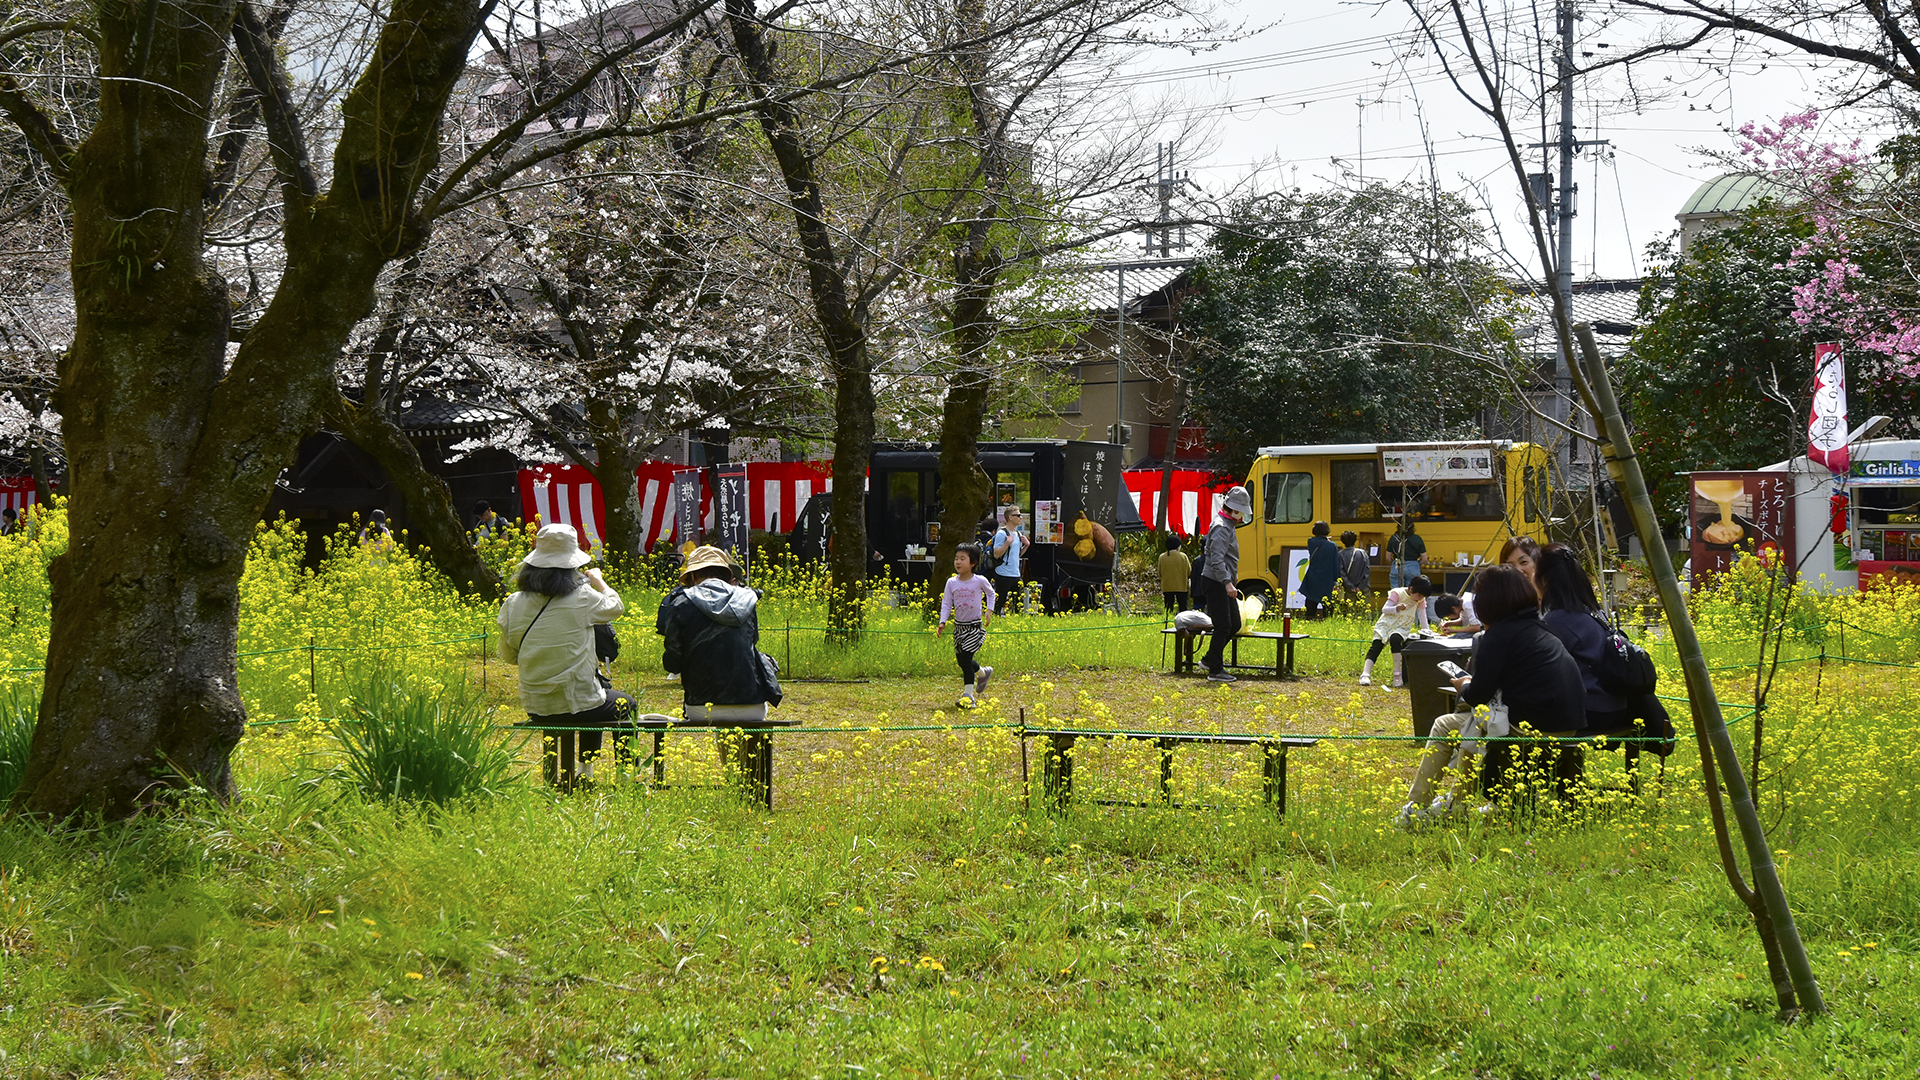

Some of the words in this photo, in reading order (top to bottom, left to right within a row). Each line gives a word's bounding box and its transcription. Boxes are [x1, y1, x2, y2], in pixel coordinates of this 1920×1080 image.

[1080, 461, 1091, 511] ほくほく。
[1095, 450, 1105, 489] 焼き芋、
[1865, 462, 1920, 476] Girlish-
[1758, 479, 1769, 541] チーズポテト
